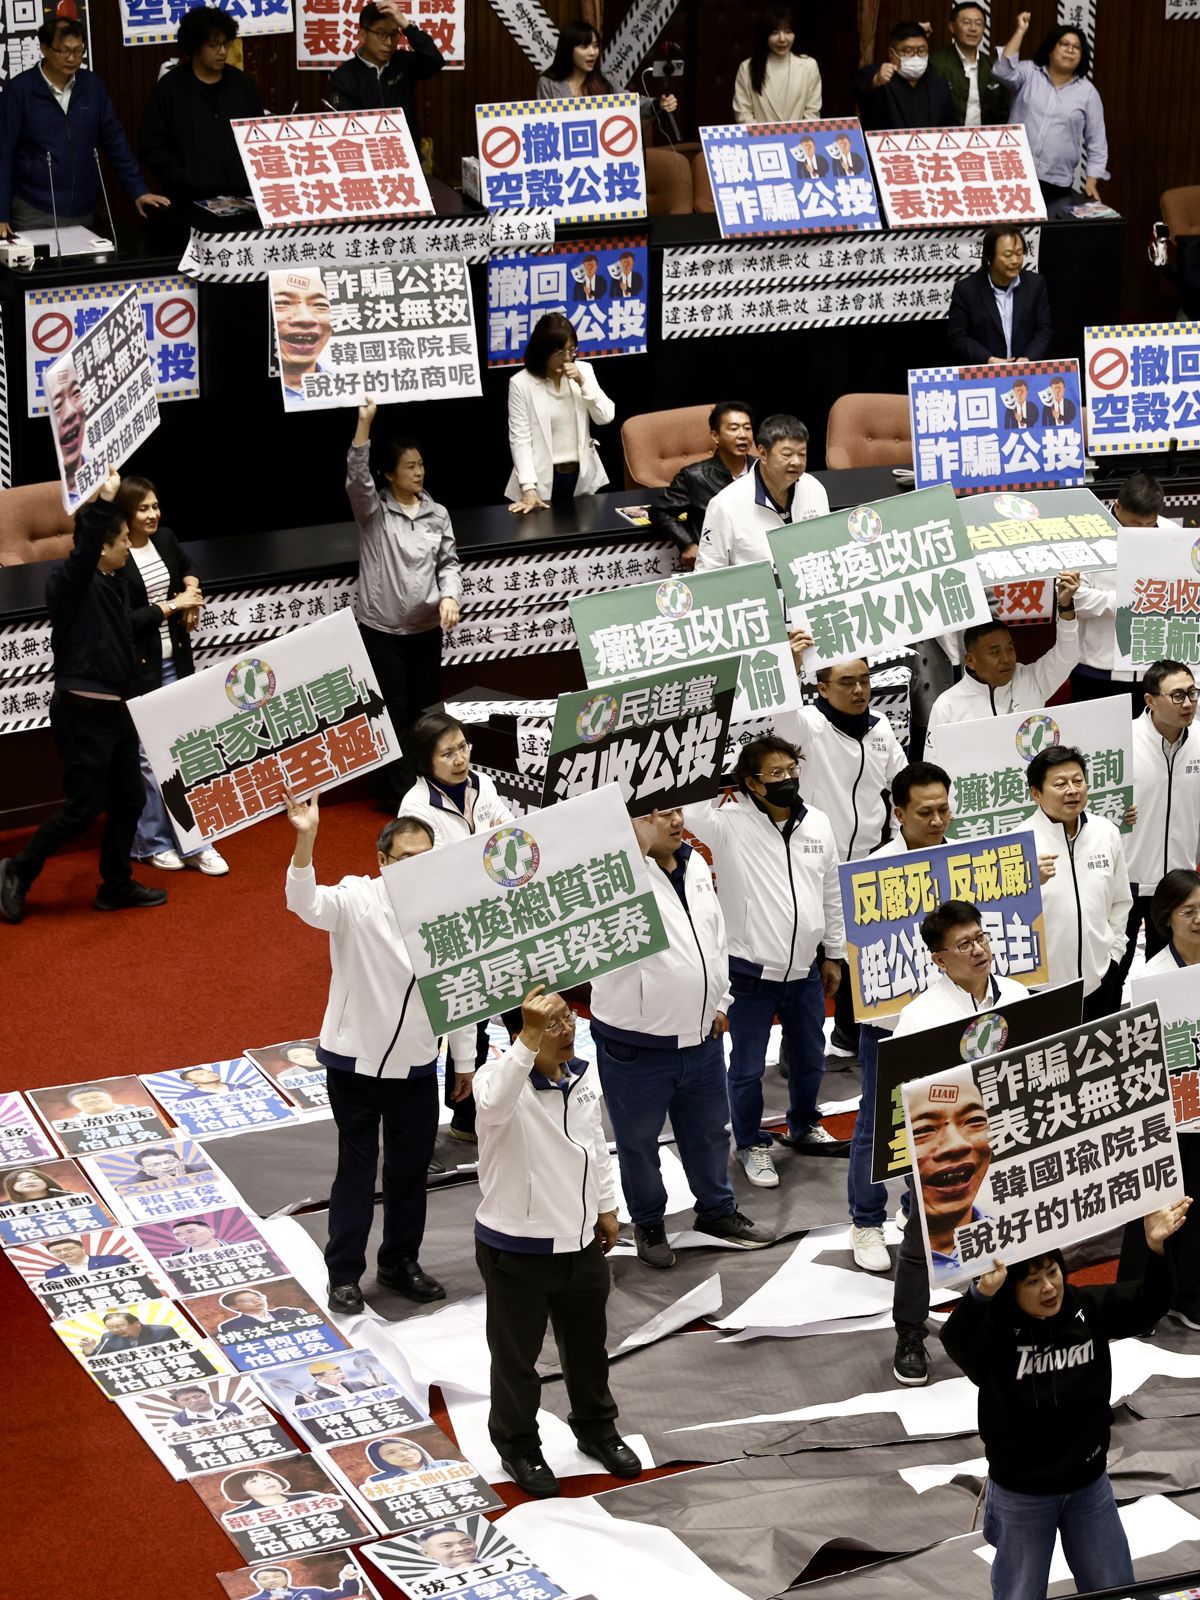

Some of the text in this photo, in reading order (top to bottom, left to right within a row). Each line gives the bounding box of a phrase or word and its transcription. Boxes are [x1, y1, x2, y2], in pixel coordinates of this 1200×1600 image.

[247, 136, 410, 181] 違法會議
[522, 120, 600, 164] 撤回
[709, 142, 789, 185] 撤回
[486, 162, 642, 215] 空殼公投
[879, 150, 1028, 184] 違法會議
[262, 173, 421, 219] 表決無效
[718, 177, 878, 226] 詐騙公投
[890, 184, 1037, 219] 表決無效
[263, 242, 337, 266] 決議無效
[344, 236, 417, 259] 違法會議
[665, 242, 960, 279] 違法會議 決議無效 違法會議 決議無效
[325, 261, 466, 301] 詐騙公投
[488, 262, 567, 309] 撤回
[331, 293, 470, 333] 表決無效
[665, 303, 734, 325] 違法會議
[741, 297, 809, 319] 決議無效
[817, 292, 885, 314] 違法會議
[73, 293, 143, 383] 詐騙公投
[330, 333, 473, 366] 韓國瑜院長
[82, 328, 150, 413] 表決無效
[304, 363, 476, 399] 說好的協商呢
[86, 366, 154, 449] 韓國瑜院長
[916, 387, 998, 433] 撤回
[919, 428, 1083, 482] 詐騙公投
[503, 564, 580, 592] 違法會議
[587, 556, 662, 582] 決議無效
[789, 517, 956, 601] 癱瘓政府
[191, 607, 240, 633] 無效
[249, 597, 326, 624] 違法會議
[805, 567, 975, 661] 薪水小偷
[589, 597, 771, 675] 癱瘓政府
[616, 673, 719, 732] 民進黨
[553, 713, 723, 802] 沒收公投
[953, 747, 1125, 815] 癱瘓詢
[418, 848, 636, 970] 癱瘓總質詢
[435, 902, 653, 1023] 羞辱卓榮泰
[976, 1011, 1161, 1106] 詐騙公投
[930, 1086, 958, 1102] LIAR
[990, 1057, 1168, 1157] 表決無效
[78, 1130, 162, 1151] 怕罷免
[989, 1113, 1174, 1206] 韓國瑜院長
[15, 1218, 102, 1241] 怕罷免
[957, 1154, 1180, 1265] 說好的協商呢
[188, 1267, 275, 1292] 怕罷免
[244, 1340, 335, 1371] 怕罷免
[114, 1366, 206, 1395] 怕罷免
[326, 1413, 415, 1441] 怕罷免
[195, 1442, 287, 1469] 怕罷免
[385, 1481, 478, 1513] 邱若華
[394, 1495, 490, 1526] 怕罷免
[247, 1513, 339, 1544] 呂玉玲
[255, 1526, 351, 1556] 怕罷免
